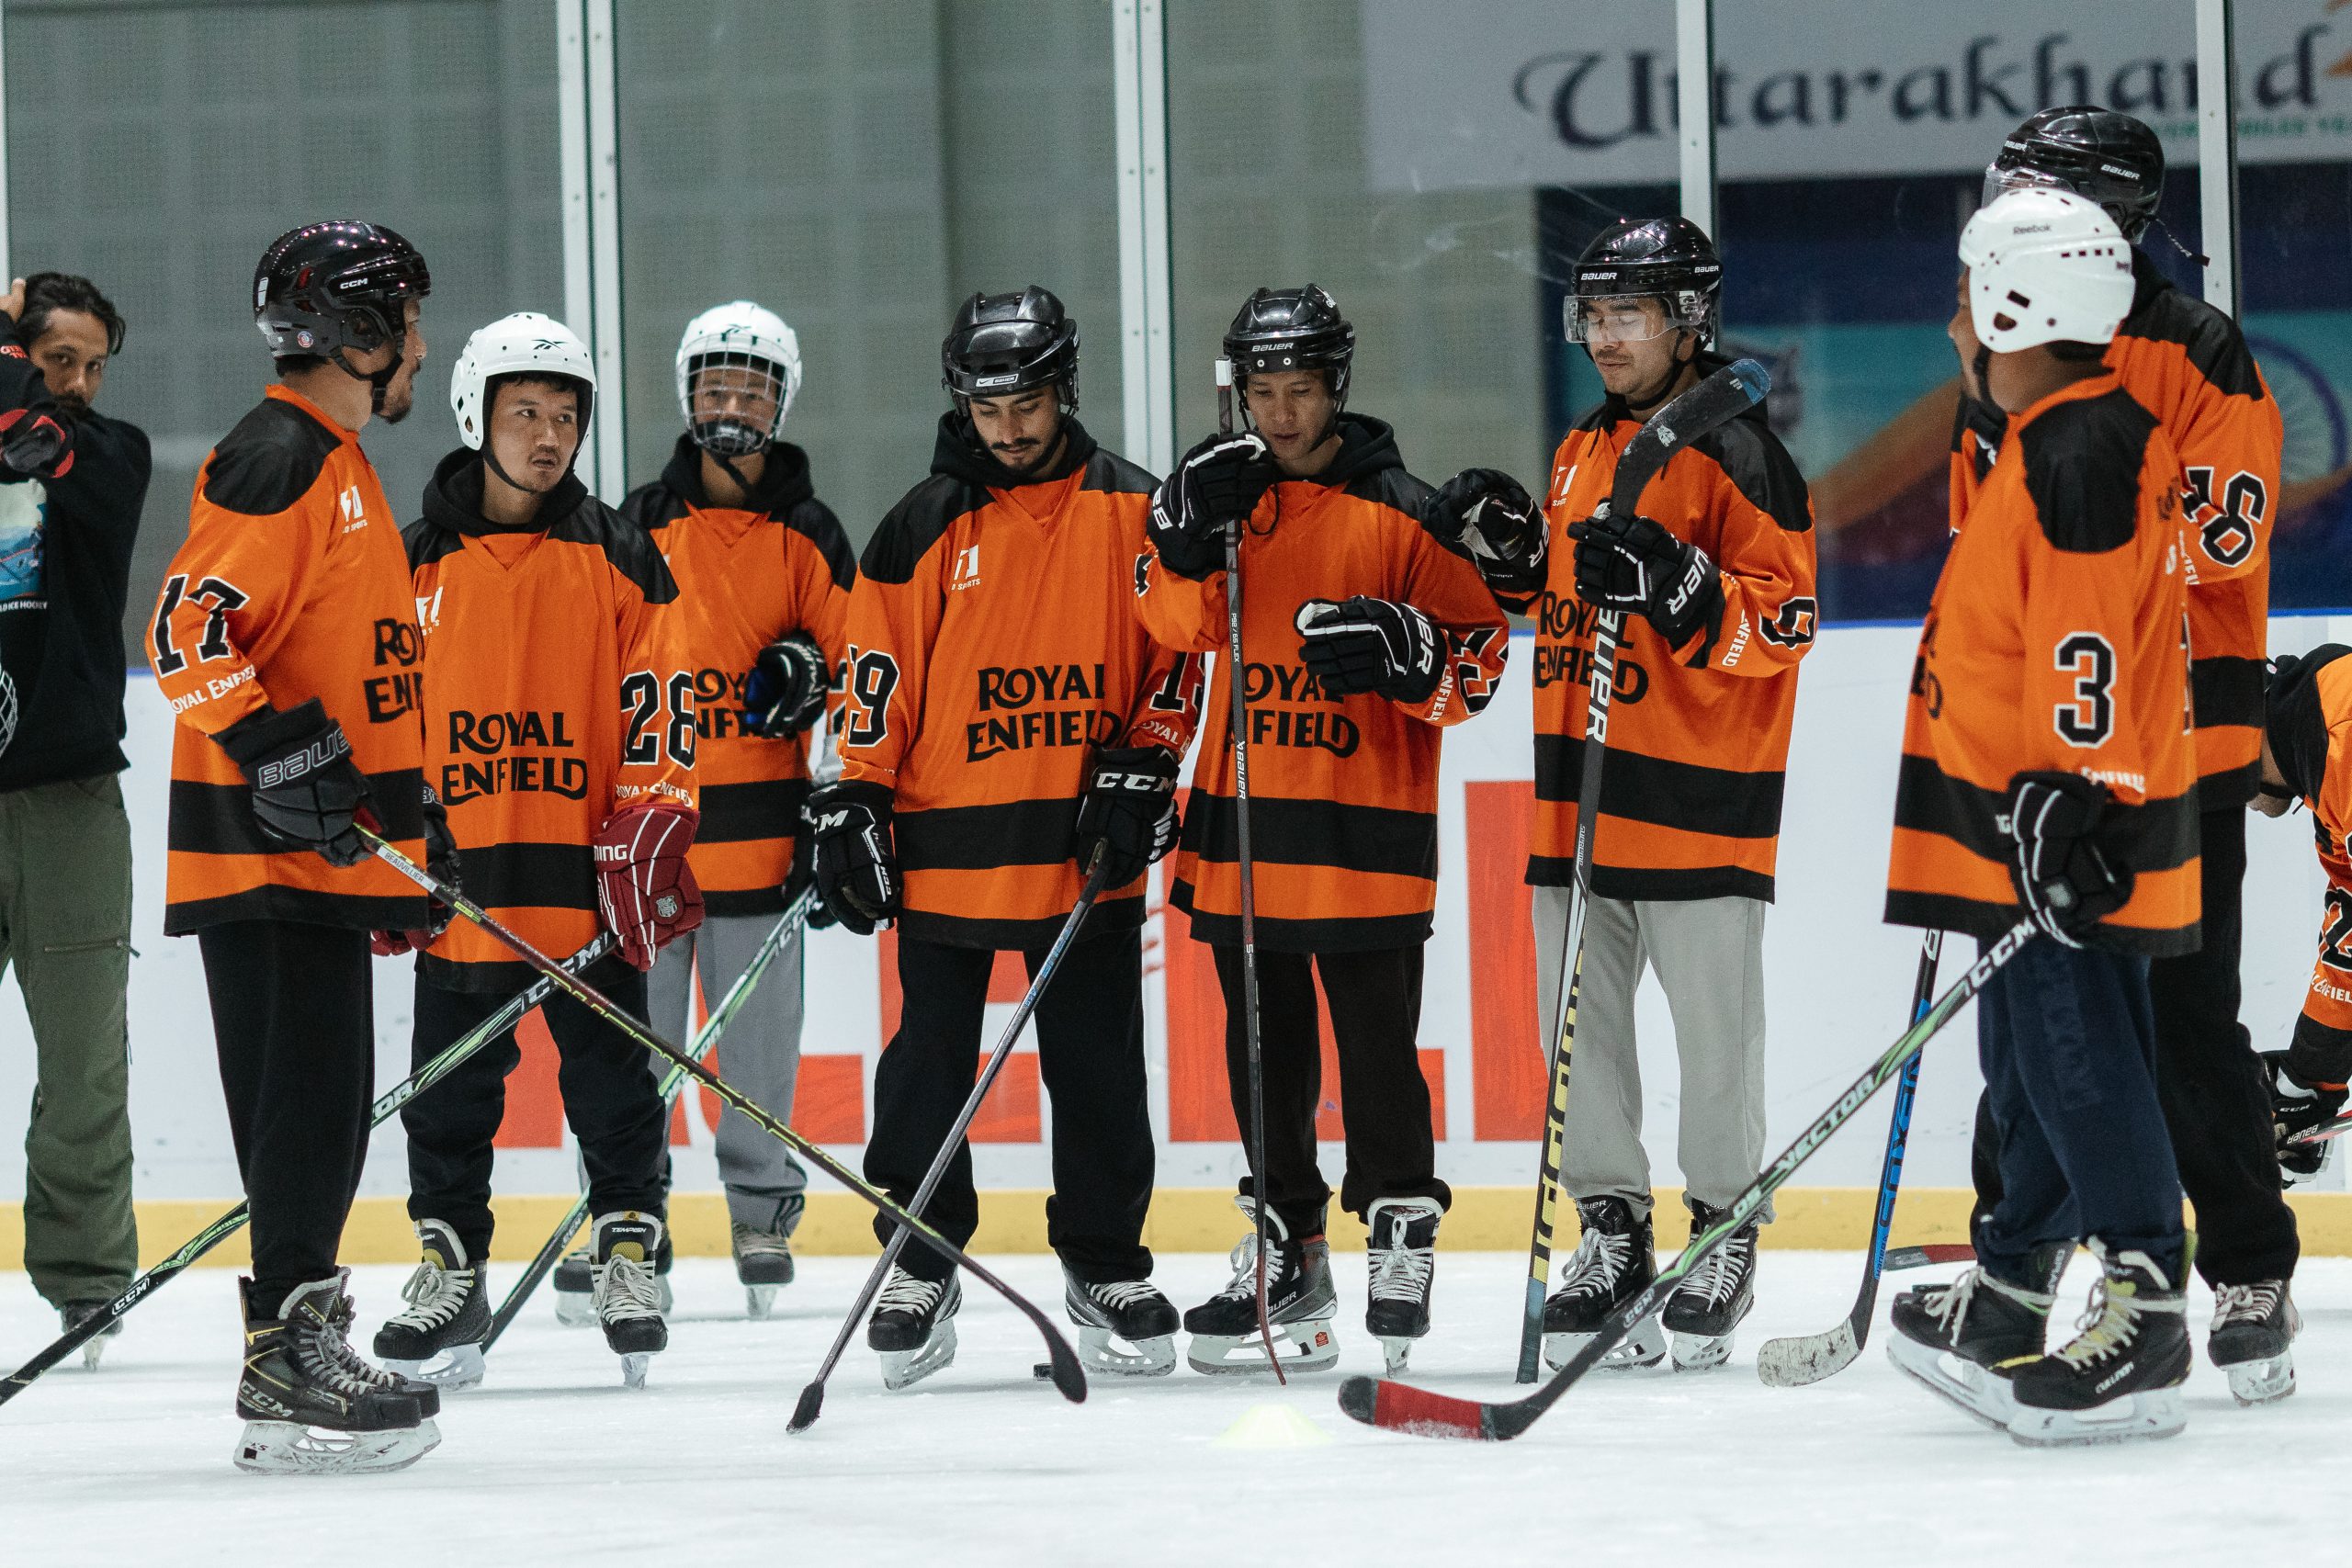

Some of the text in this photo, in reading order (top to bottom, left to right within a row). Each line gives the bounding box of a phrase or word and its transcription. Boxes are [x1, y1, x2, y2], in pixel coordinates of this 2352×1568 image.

[2100, 164, 2141, 180] BAUER
[340, 277, 368, 289] CCM
[1580, 272, 1618, 281] BAUER
[1695, 265, 1720, 274] BAUER
[1251, 342, 1294, 352] BAUER
[153, 573, 251, 679] 17
[2053, 631, 2117, 750] 3
[448, 709, 574, 755] ROYAL
[619, 669, 696, 771] 28
[966, 709, 1123, 763] ENFIELD
[442, 755, 588, 807] ENFIELD
[1096, 772, 1178, 793] CCM
[1237, 750, 1247, 800] BAUER
[384, 852, 425, 884] BEAUVILLIER
[881, 865, 892, 897] CCM
[1969, 917, 2037, 989] CCM
[1774, 1073, 1876, 1171] VECTOR
[2287, 1123, 2319, 1145] BAUER
[113, 1280, 147, 1311] CCM
[241, 1382, 294, 1418] CCM
